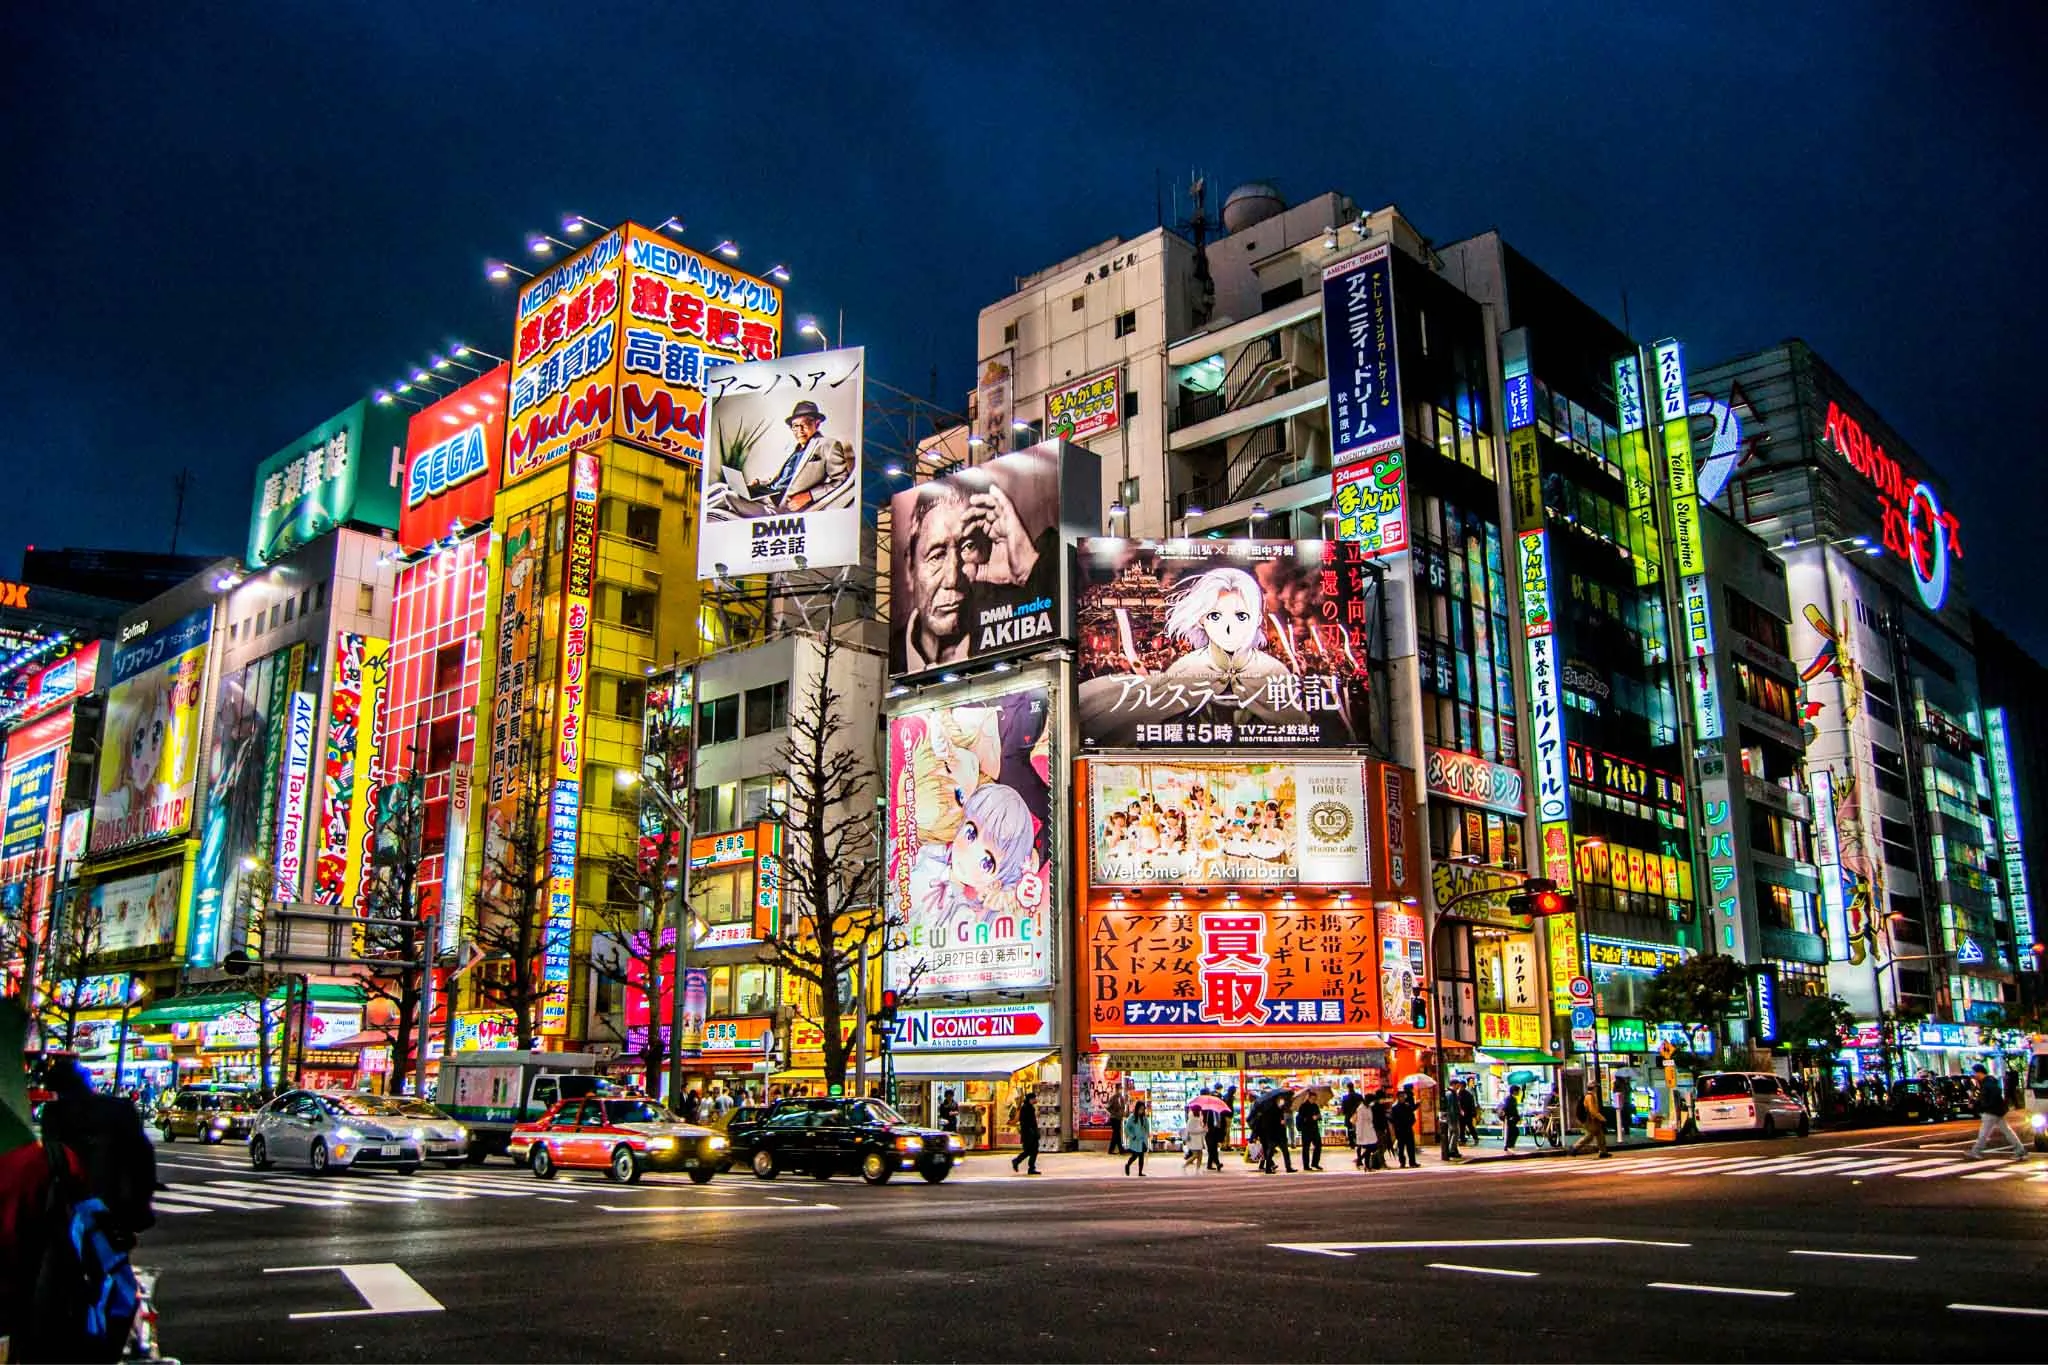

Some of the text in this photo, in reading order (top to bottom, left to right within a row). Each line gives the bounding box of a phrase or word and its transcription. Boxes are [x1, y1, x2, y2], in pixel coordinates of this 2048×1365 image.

[519, 231, 622, 320] MEDIAリサイクル
[632, 239, 780, 315] MEDIAリサイクル
[1359, 248, 1385, 264] DREAM
[518, 270, 618, 363] 激安販売
[629, 274, 775, 362] 激安販売
[512, 322, 615, 418] 高額買取
[1346, 271, 1377, 440] アメニティードリーム
[1050, 376, 1116, 418] まんが喫茶
[1661, 350, 1681, 414] スーパービル
[509, 384, 612, 476] Mulan
[636, 429, 684, 454] ムーラン
[408, 423, 490, 508] SEGA
[575, 502, 594, 515] DVD
[1336, 484, 1401, 516] まんが
[1670, 451, 1694, 569] Yellow Submarine
[751, 517, 807, 539] DMM
[751, 536, 807, 559] 英会話
[1522, 533, 1542, 581] まんが
[121, 619, 150, 642] Sofmap
[979, 611, 1054, 651] AKIBA
[490, 591, 517, 803] 激安販売の専門店
[1109, 672, 1342, 719] アルスラーン戦記
[294, 695, 313, 752] AKKY
[1146, 723, 1184, 743] 日曜
[1198, 723, 1234, 744] 5時
[1238, 723, 1321, 736] TVアニメ放送中
[284, 770, 307, 854] Tax-free
[454, 768, 469, 809] GAME
[715, 834, 744, 854] 吉野家
[760, 855, 772, 907] 吉野家
[1101, 861, 1299, 880] Welcome to Akihabara
[1705, 800, 1736, 948] リバティー
[956, 911, 1043, 945] GAME!
[1148, 914, 1169, 975] アニメ
[1296, 914, 1318, 975] ホビー
[1123, 914, 1146, 996] アイドル
[1171, 913, 1197, 999] 美少女系
[1197, 912, 1271, 1026] 買取
[1272, 914, 1297, 998] フィギュア
[1319, 913, 1345, 998] 携帯電話
[1513, 953, 1528, 1005] ルノアール
[544, 1007, 565, 1016] AKIBA
[1125, 1000, 1343, 1024] チケット 大黒屋
[1574, 981, 1588, 993] 40
[1757, 973, 1771, 1038] GALLERIA
[707, 1022, 737, 1039] 吉野家
[931, 1038, 978, 1047] Akihabara
[932, 1015, 1015, 1037] COMIC ZIN
[1610, 1026, 1646, 1042] リバティー
